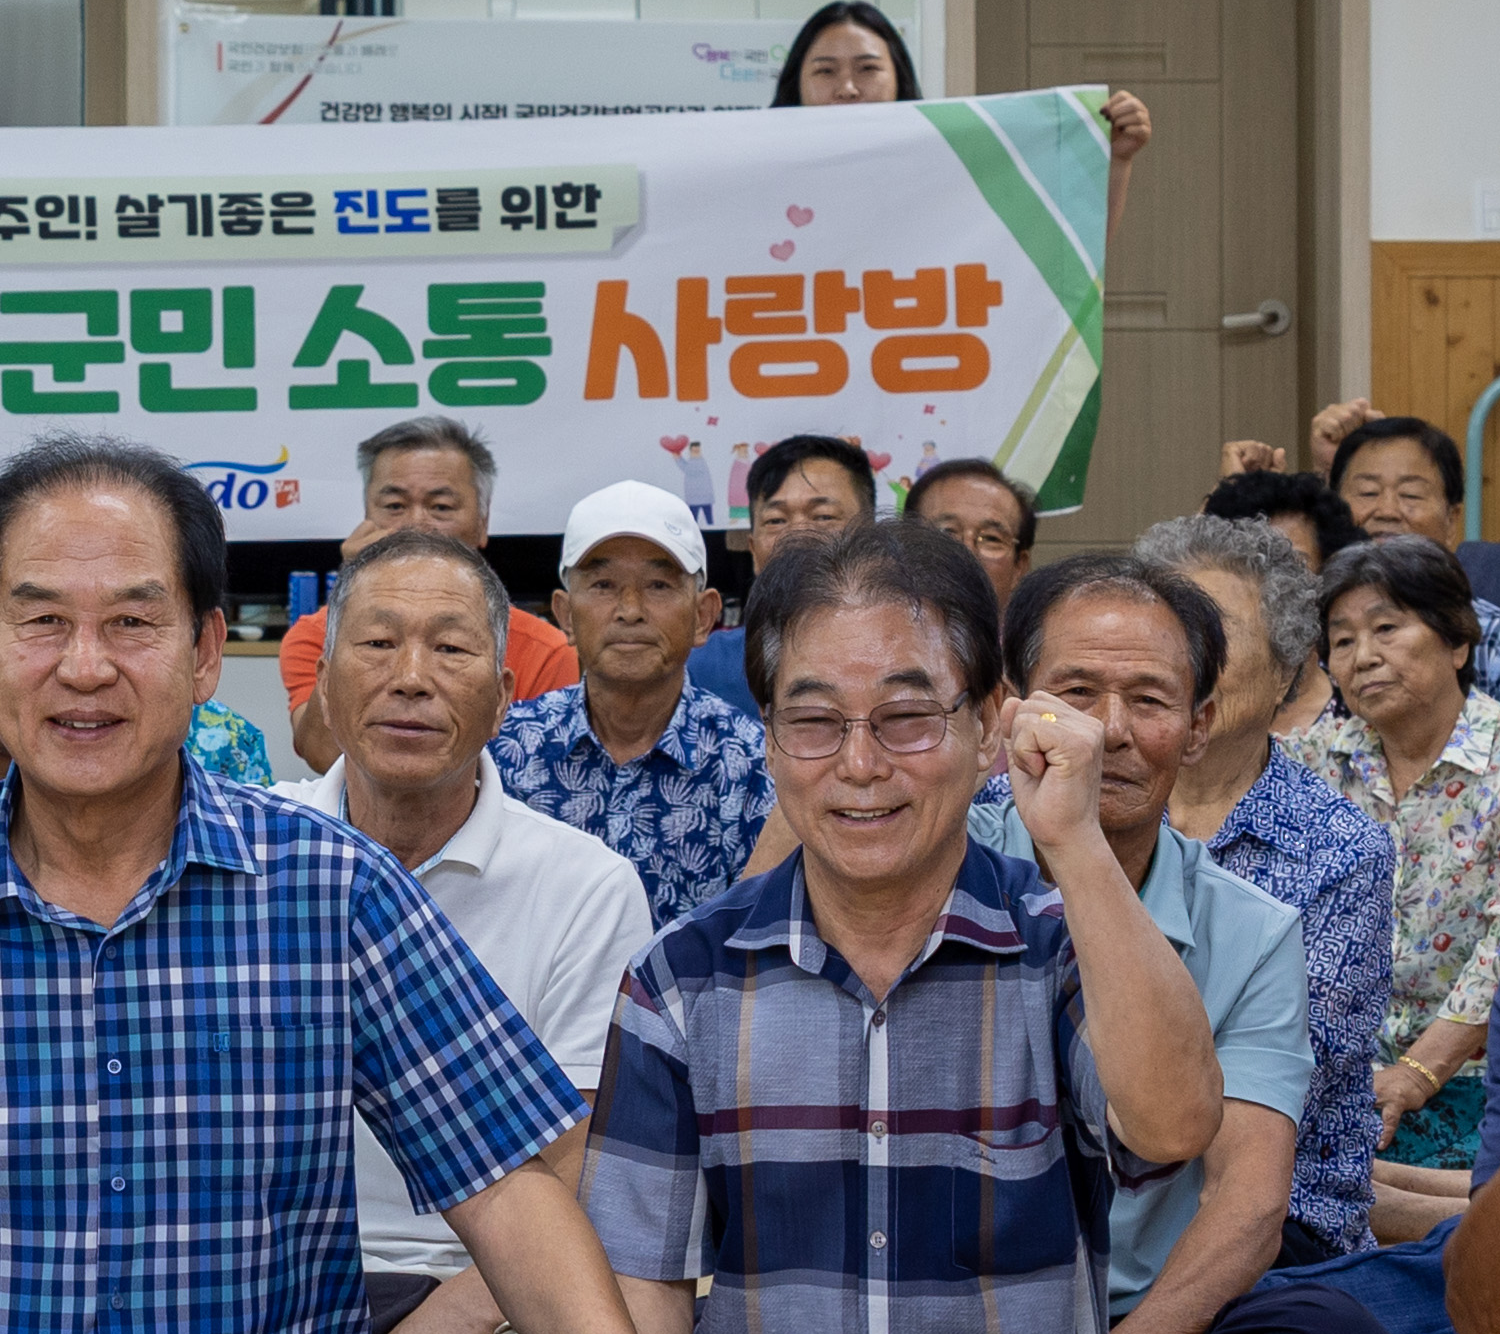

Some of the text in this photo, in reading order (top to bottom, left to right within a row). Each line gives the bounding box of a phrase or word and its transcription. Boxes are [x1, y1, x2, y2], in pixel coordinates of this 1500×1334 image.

[320, 101, 383, 123] 건강한
[389, 102, 453, 122] 행복의
[115, 191, 317, 238] 살기좋은
[334, 187, 483, 234] 진도를
[499, 181, 602, 231] 위한
[288, 281, 552, 410] 소통
[584, 263, 1002, 402] 사랑방
